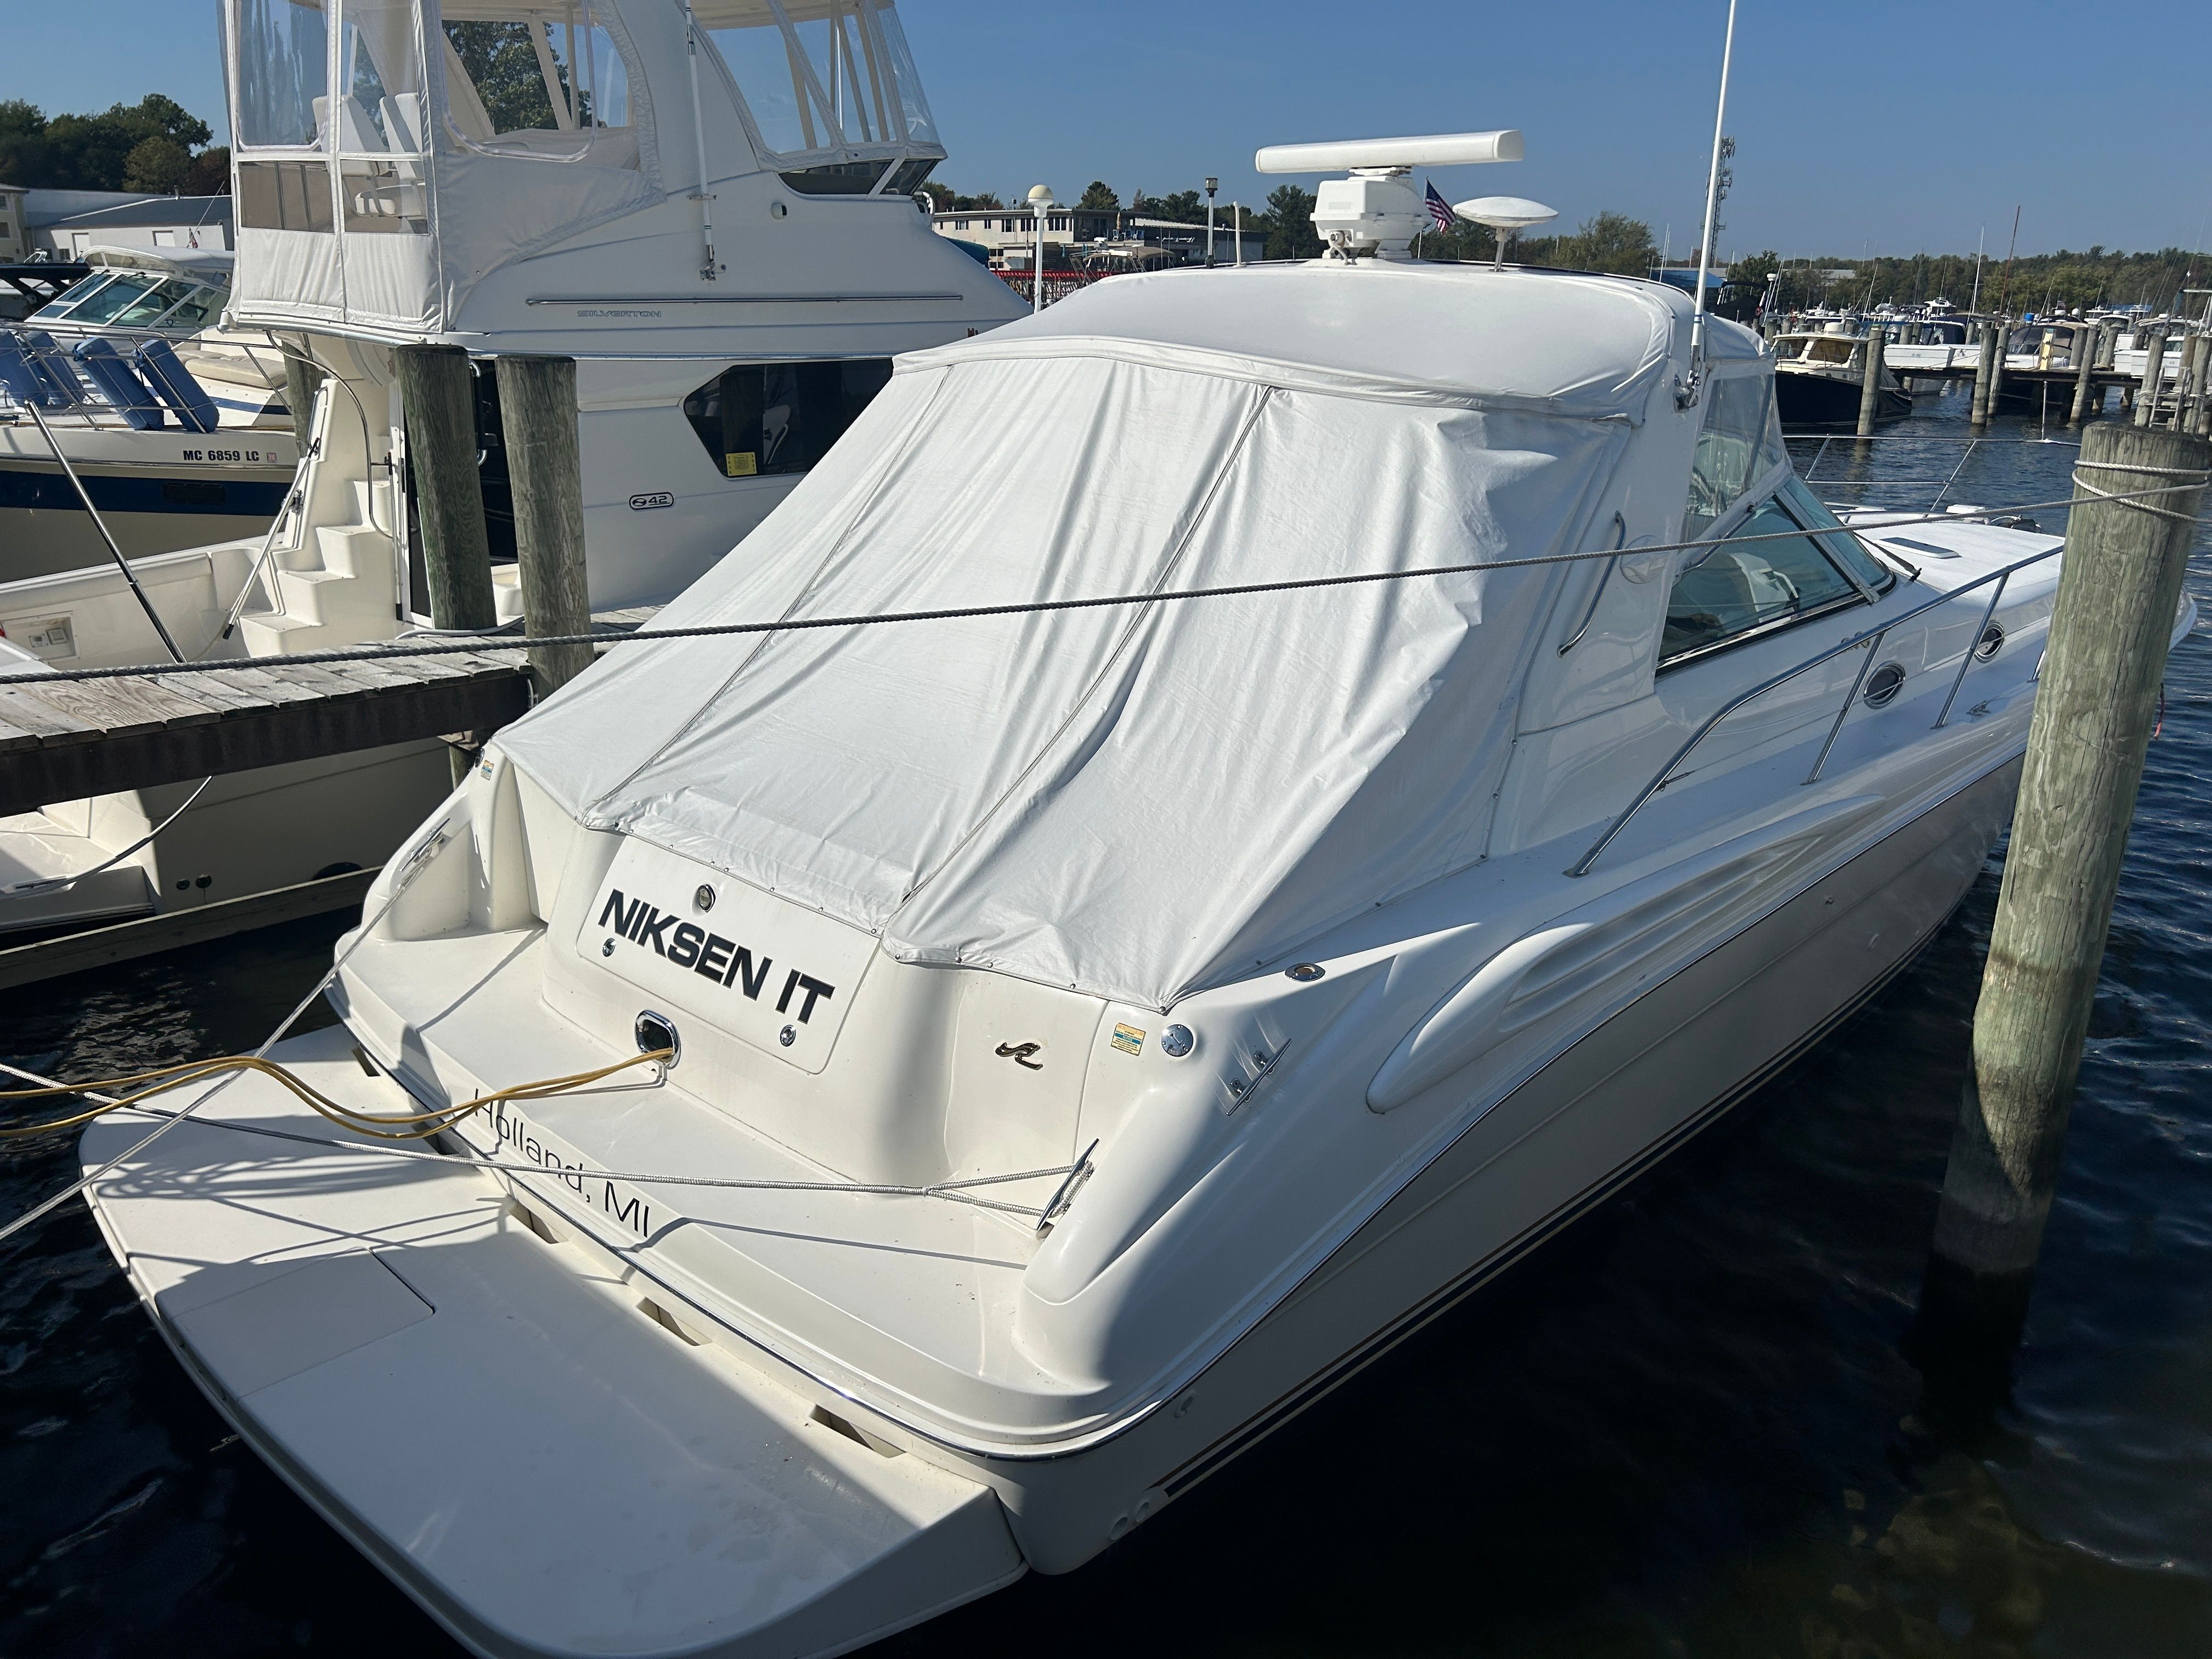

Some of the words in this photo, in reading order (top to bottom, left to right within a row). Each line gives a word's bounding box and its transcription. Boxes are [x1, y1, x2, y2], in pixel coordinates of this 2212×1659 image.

[183, 450, 203, 461] MC
[207, 450, 241, 461] 6859
[245, 450, 259, 461] LC
[648, 495, 668, 504] 42
[597, 888, 773, 1001] NIKSEN
[775, 968, 836, 1025] IT
[605, 1180, 650, 1238] MI
